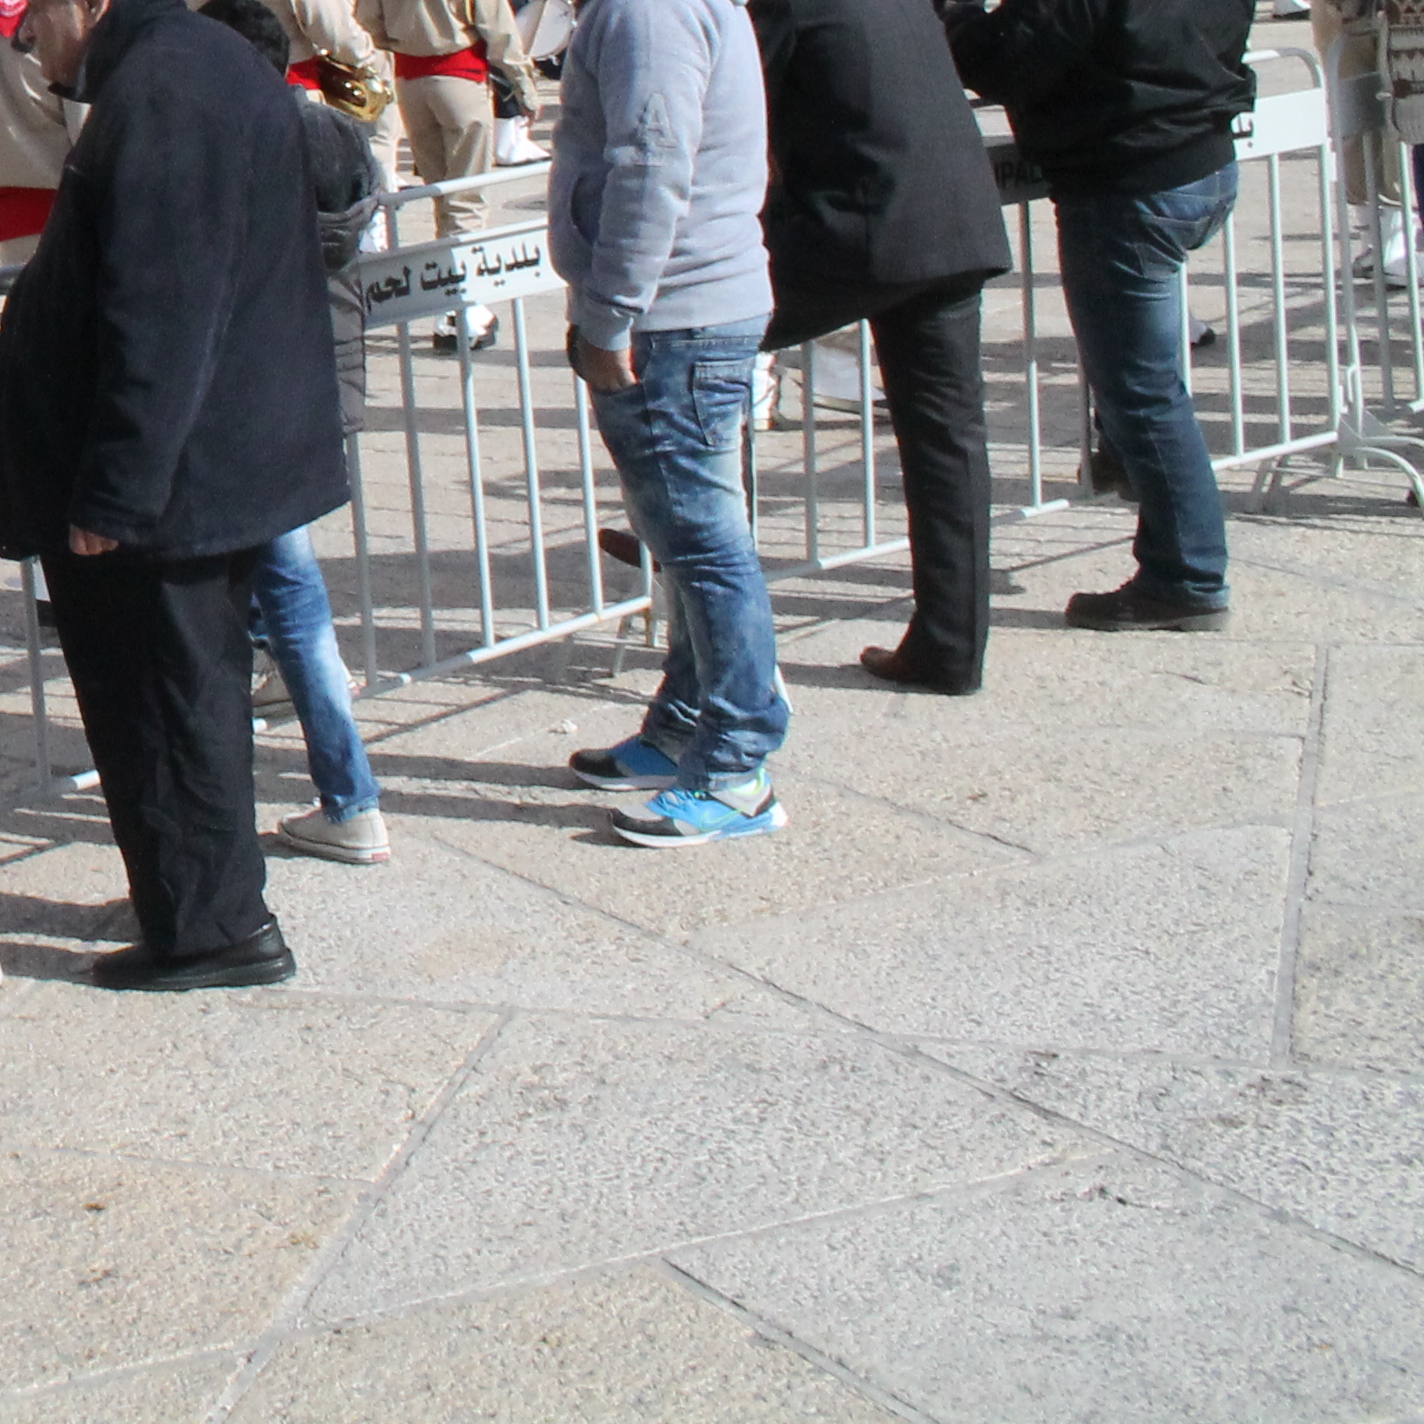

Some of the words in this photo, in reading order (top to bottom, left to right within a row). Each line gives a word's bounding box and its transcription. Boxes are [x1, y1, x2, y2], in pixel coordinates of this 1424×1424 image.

[420, 259, 467, 297] بيت
[471, 240, 541, 287] بلدية
[365, 265, 411, 316] لحم
